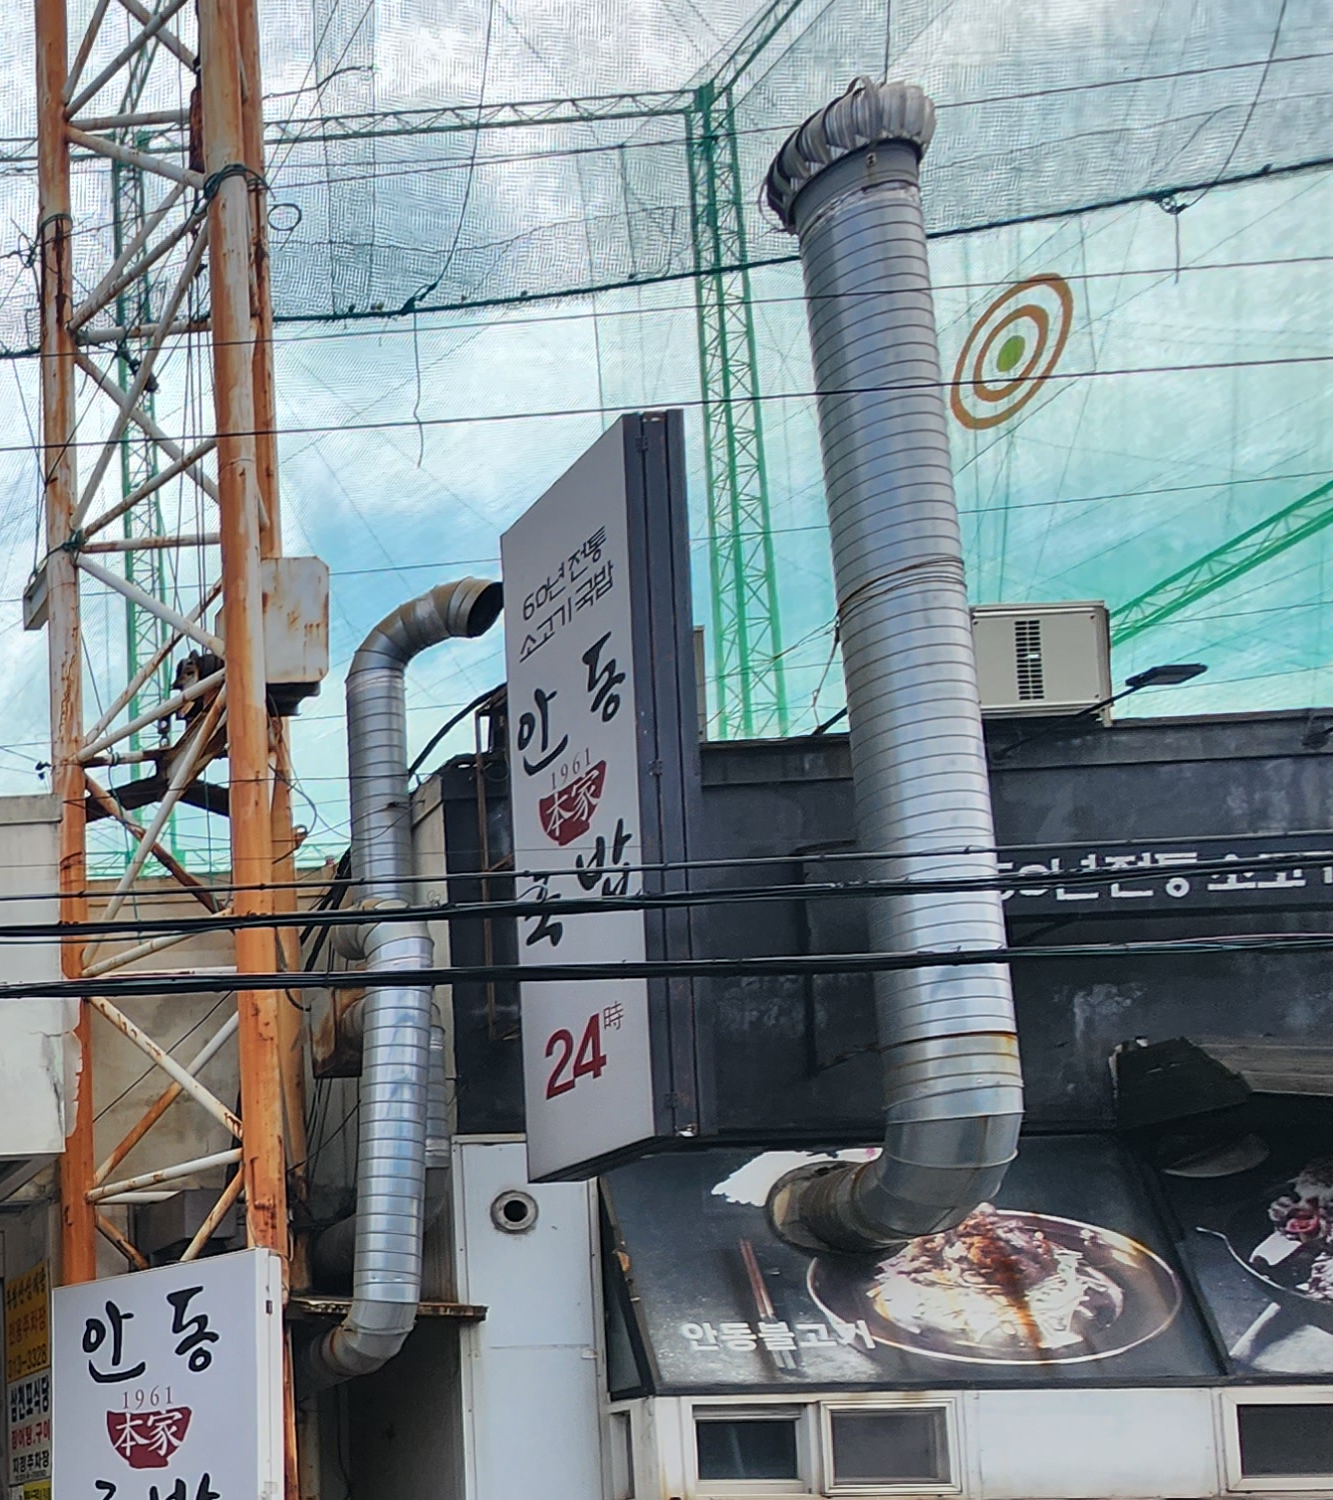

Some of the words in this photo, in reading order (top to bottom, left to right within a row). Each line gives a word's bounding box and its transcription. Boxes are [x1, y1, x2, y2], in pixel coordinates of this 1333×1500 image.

[520, 597, 572, 663] 소고기
[575, 560, 613, 612] 국밥
[523, 561, 566, 621] 60년
[568, 525, 607, 584] 전통
[518, 631, 626, 776] 안동
[546, 767, 600, 837] 本家
[551, 748, 591, 790] 1961
[82, 1286, 220, 1384] 안동
[115, 1411, 184, 1457] 本家
[123, 1386, 173, 1410] 1961
